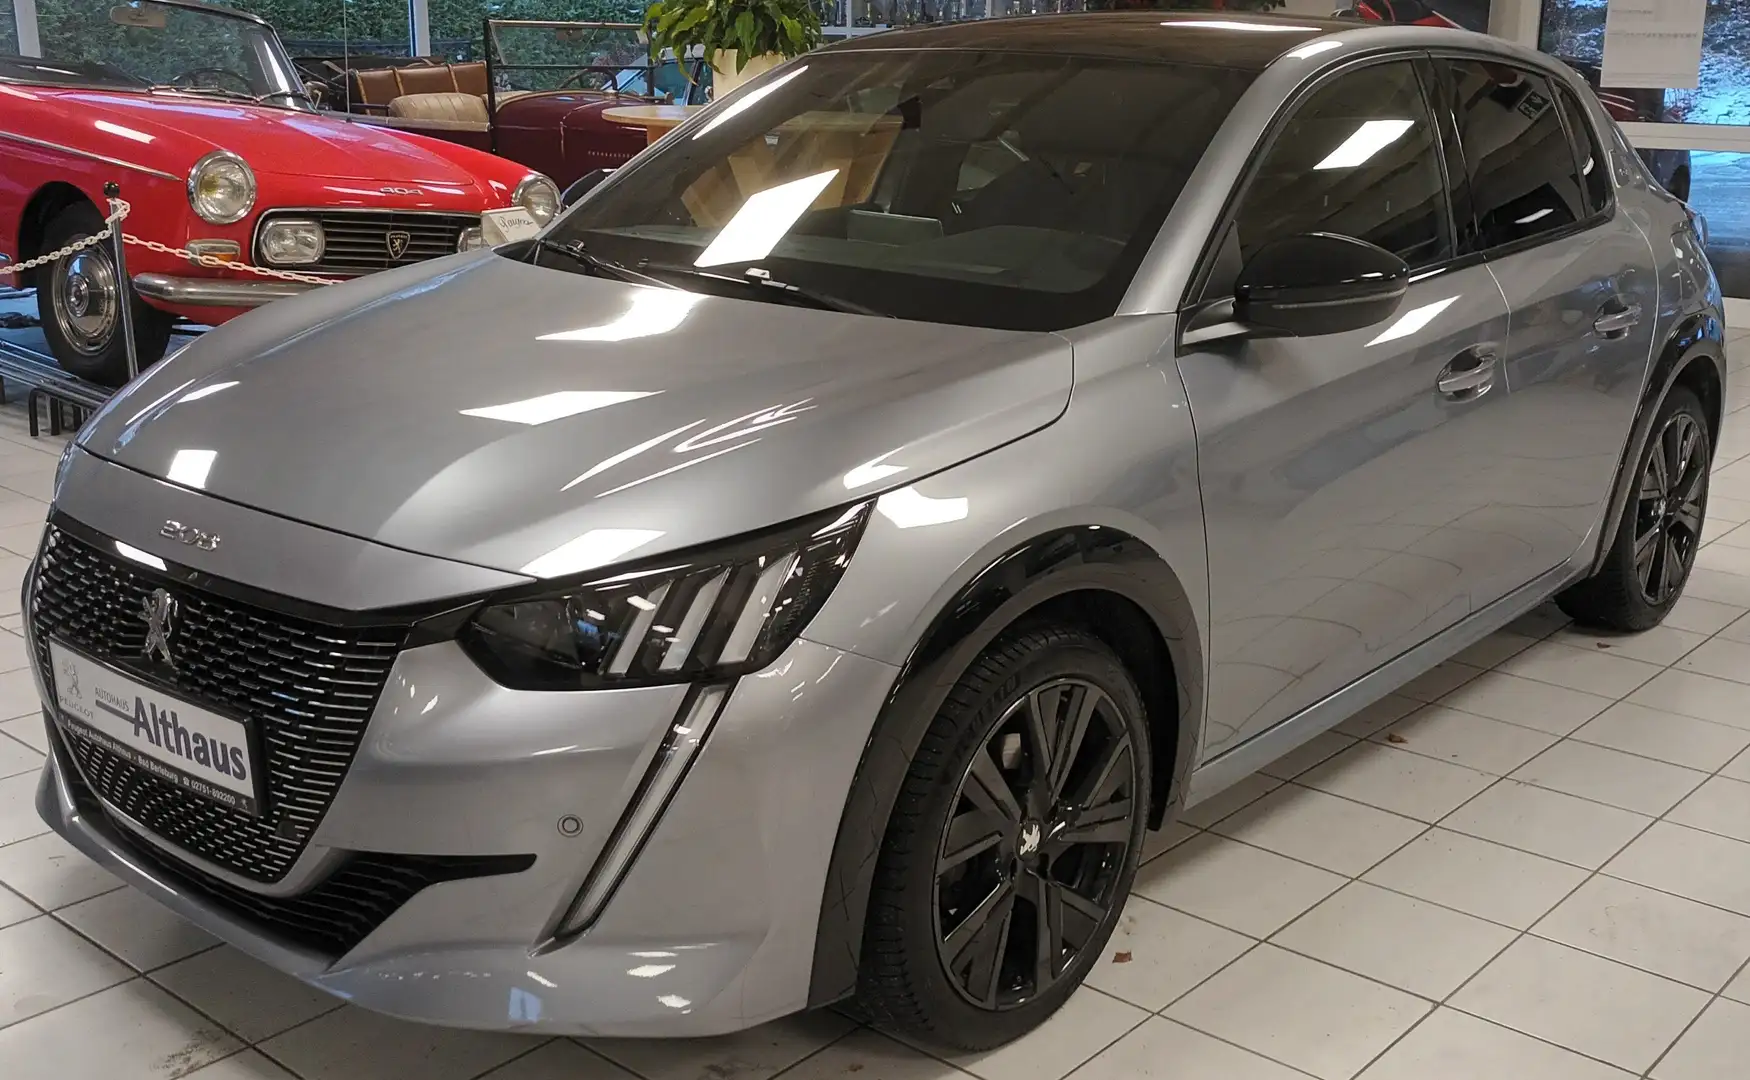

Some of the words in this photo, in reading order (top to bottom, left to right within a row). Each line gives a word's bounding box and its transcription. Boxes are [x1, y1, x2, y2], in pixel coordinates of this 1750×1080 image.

[380, 187, 424, 197] 404
[160, 519, 220, 552] 208
[60, 695, 94, 719] PEUGEOT
[95, 686, 130, 713] AUTOHAUS
[134, 695, 247, 781] Althaus
[88, 729, 111, 749] Autohaus
[112, 741, 132, 759] Althaus
[138, 755, 150, 769] Bad
[150, 761, 179, 784] Berleburg
